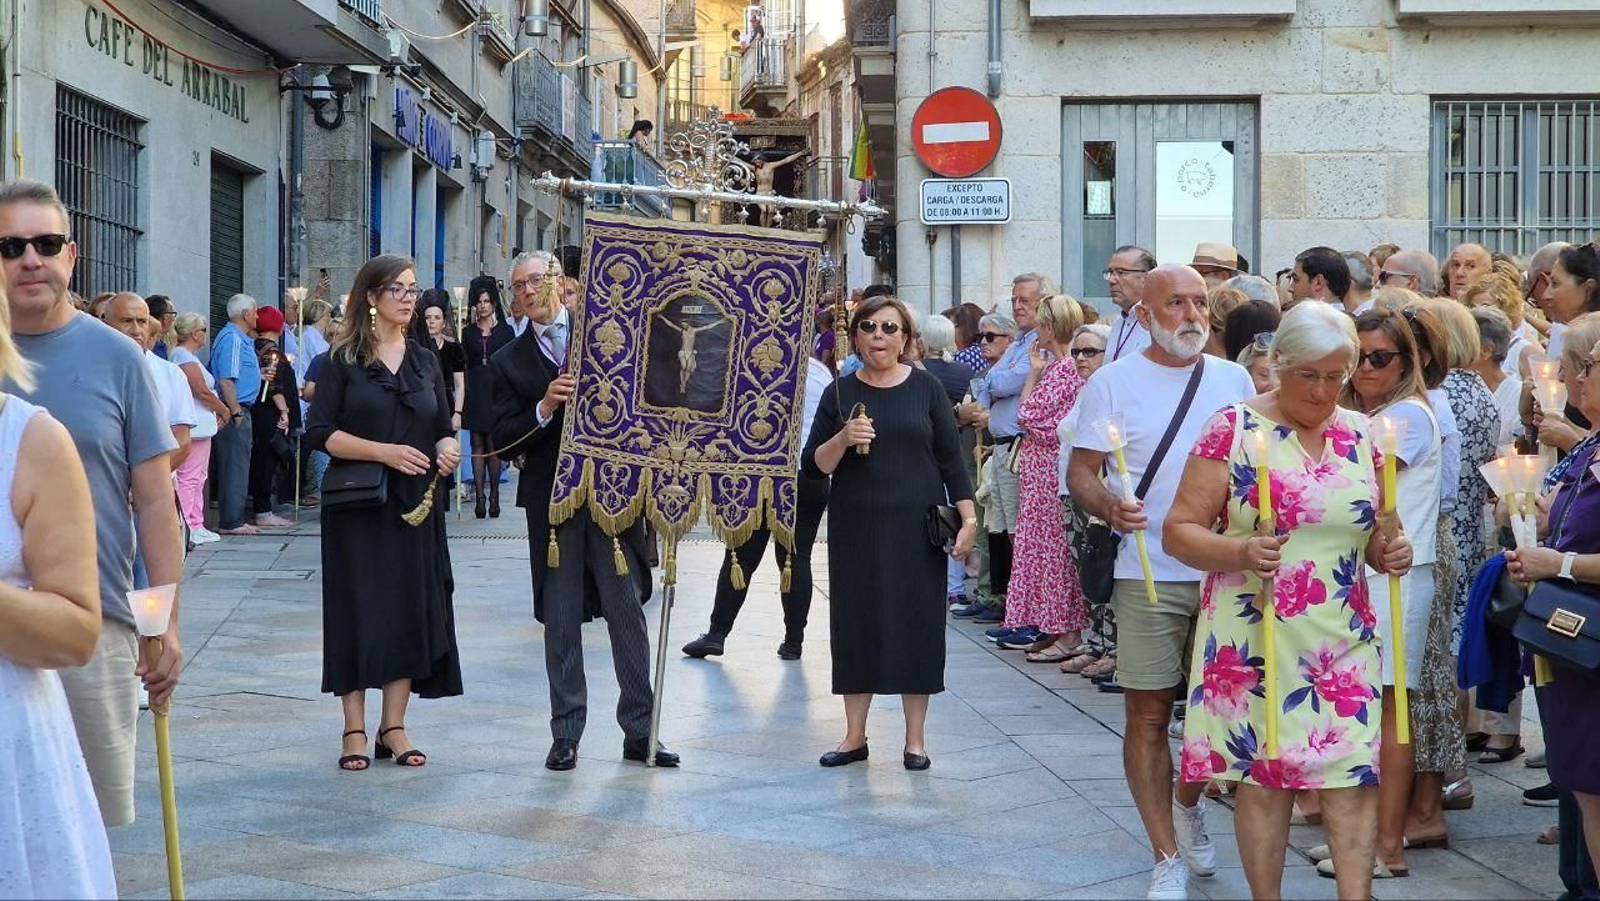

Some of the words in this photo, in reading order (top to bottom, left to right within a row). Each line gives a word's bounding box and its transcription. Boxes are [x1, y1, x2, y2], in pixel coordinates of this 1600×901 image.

[84, 5, 135, 67] CAFE
[142, 34, 173, 87] DEL
[180, 55, 249, 124] ARRABAL
[1177, 158, 1198, 183] porco
[1193, 161, 1217, 198] taberna
[946, 183, 983, 193] EXCEPTO
[926, 195, 954, 205] CARGA
[960, 195, 1003, 204] DESCARGA
[926, 208, 938, 217] DE
[939, 207, 962, 216] 08:00
[963, 208, 969, 216] A
